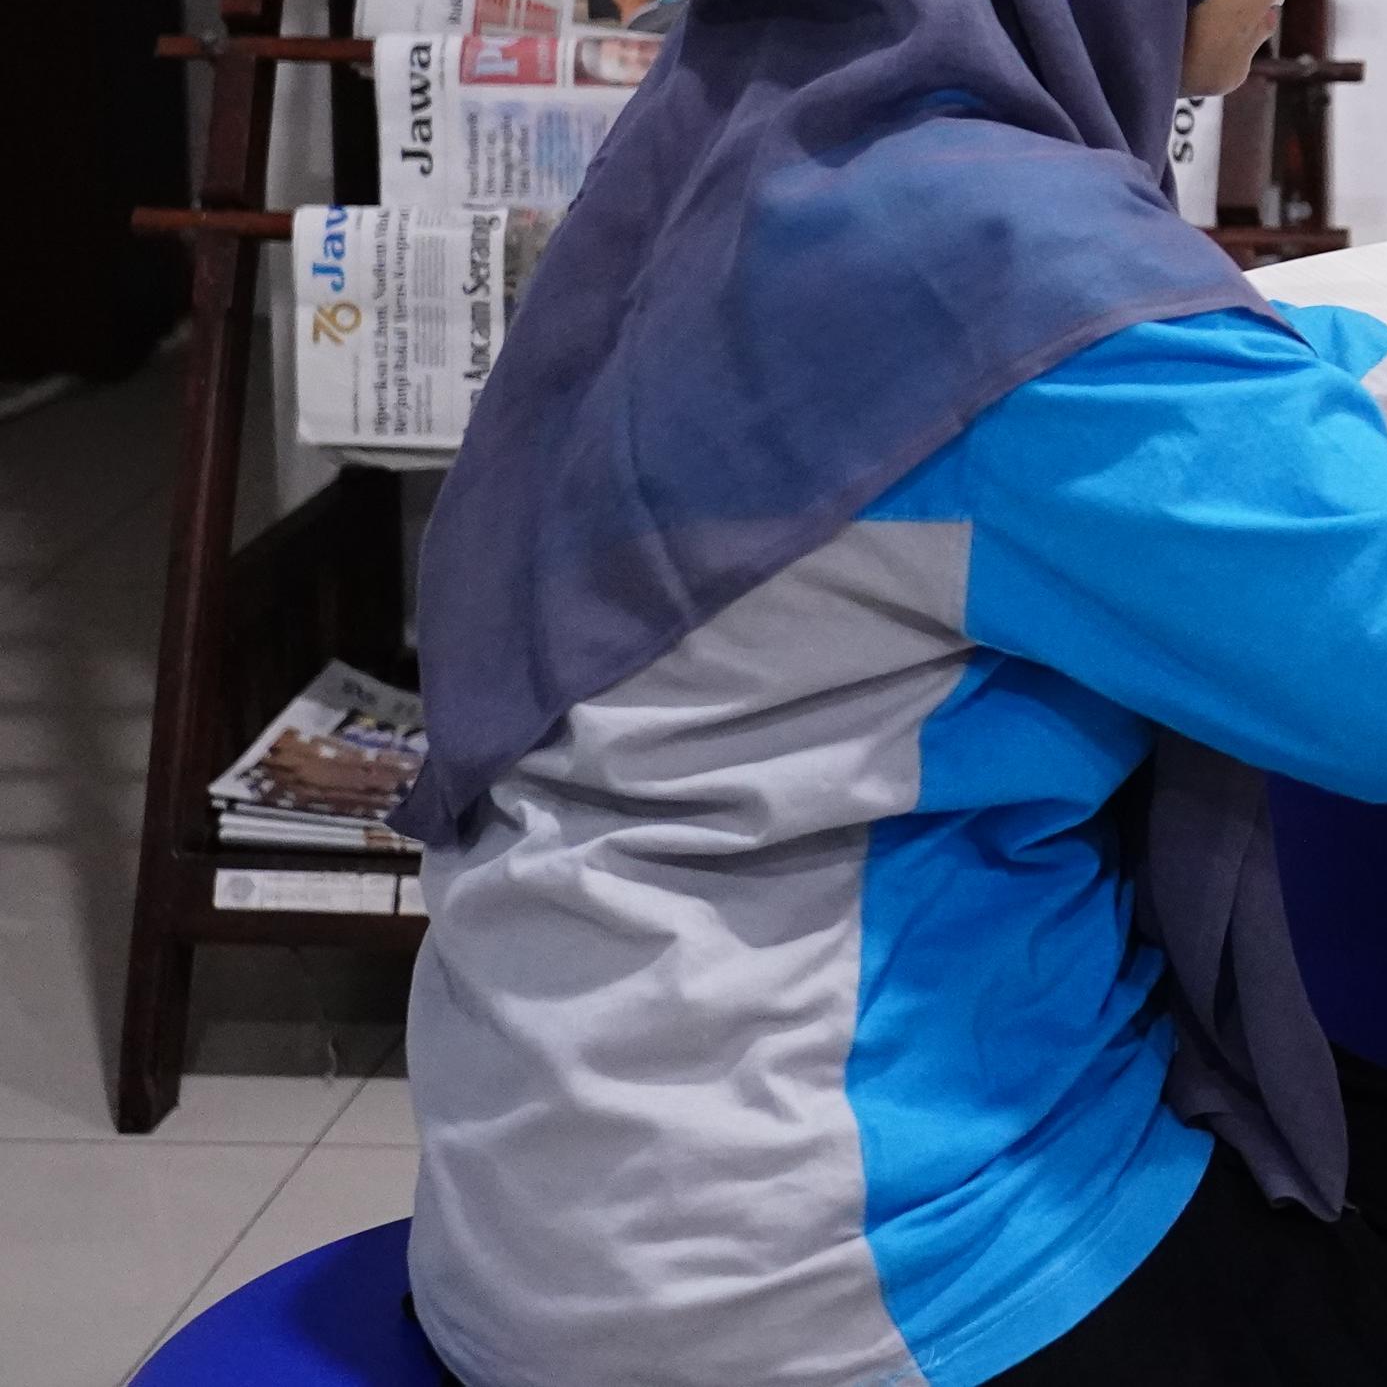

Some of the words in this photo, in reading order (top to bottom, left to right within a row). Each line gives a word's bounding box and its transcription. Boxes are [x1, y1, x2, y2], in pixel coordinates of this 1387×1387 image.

[400, 40, 434, 177] Jawa
[1172, 97, 1206, 164] os
[311, 299, 363, 346] 76
